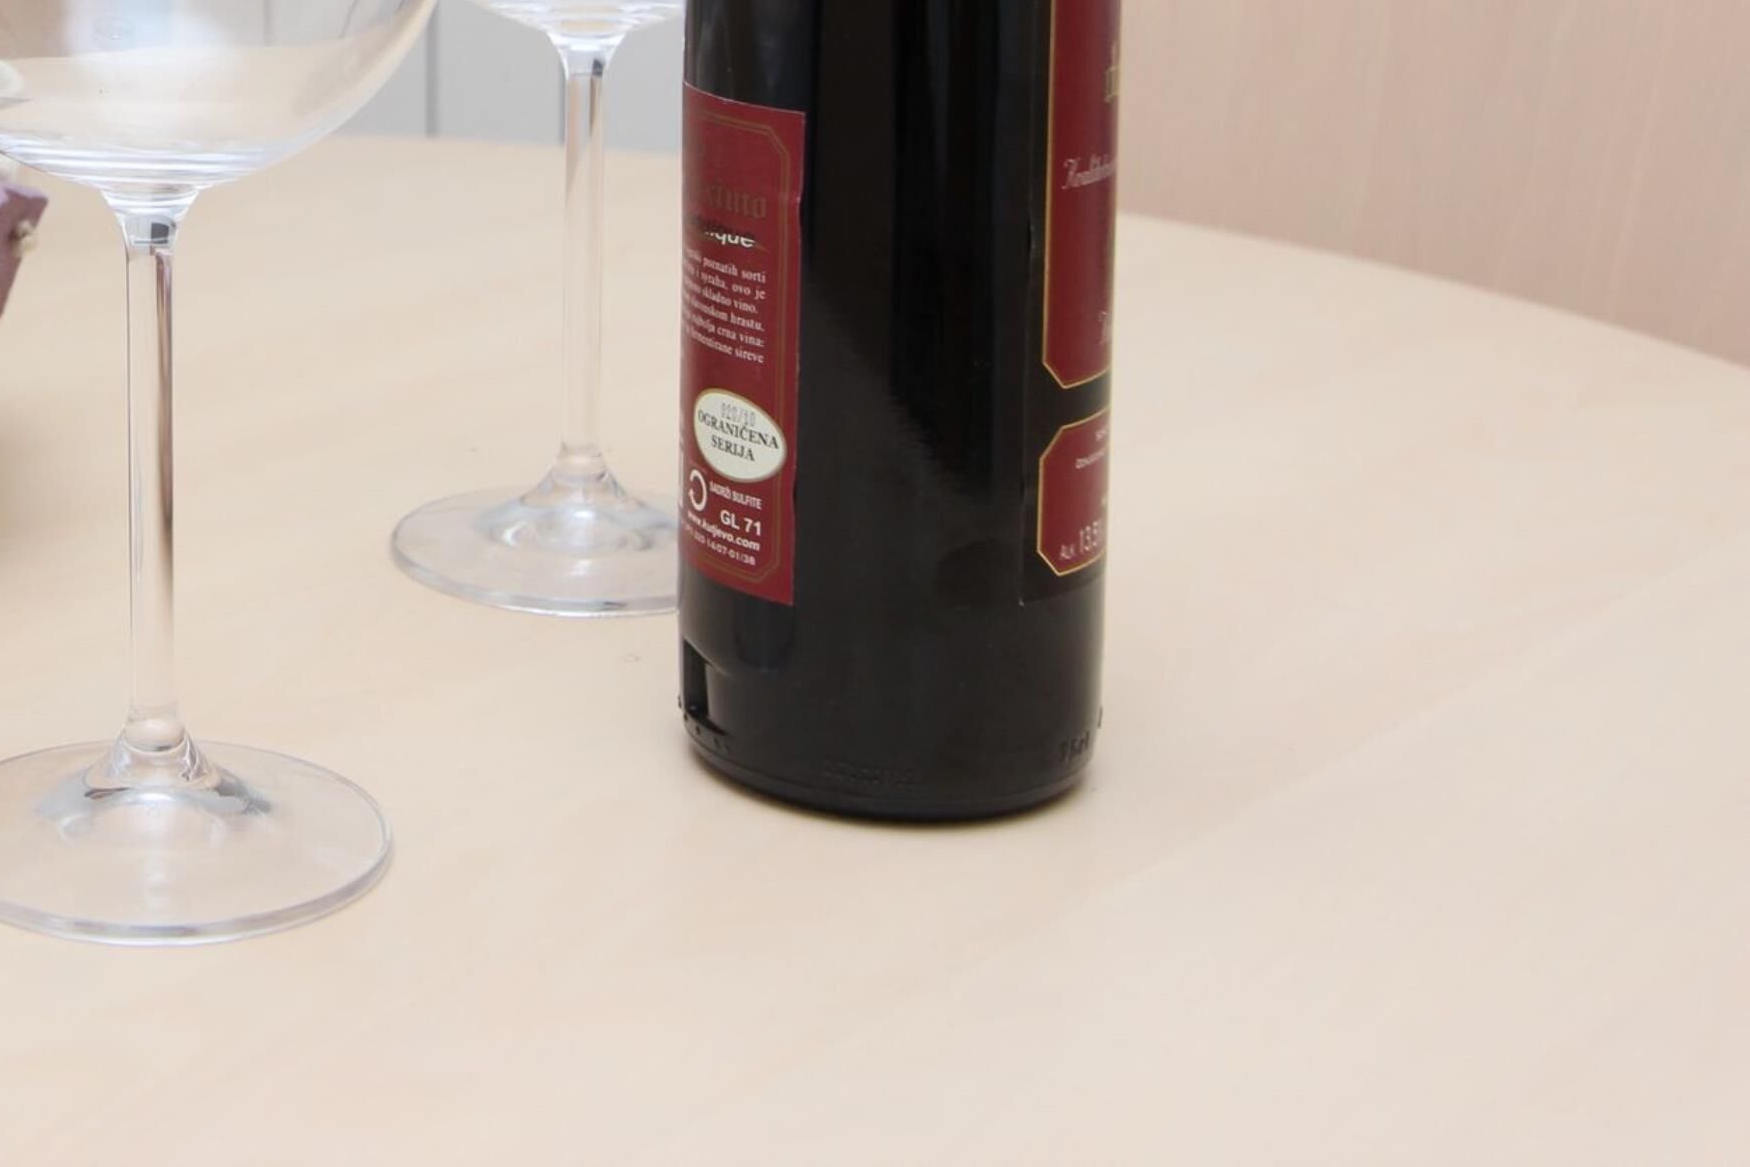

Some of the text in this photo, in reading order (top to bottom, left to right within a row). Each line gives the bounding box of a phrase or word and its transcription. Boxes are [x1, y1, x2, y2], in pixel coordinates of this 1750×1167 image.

[741, 268, 767, 284] sorti
[732, 283, 752, 295] ovo
[754, 288, 767, 301] je
[733, 299, 758, 313] vino.
[697, 409, 780, 450] OGRANIČENA
[710, 434, 755, 462] SERIJA
[720, 509, 762, 537] GL 71
